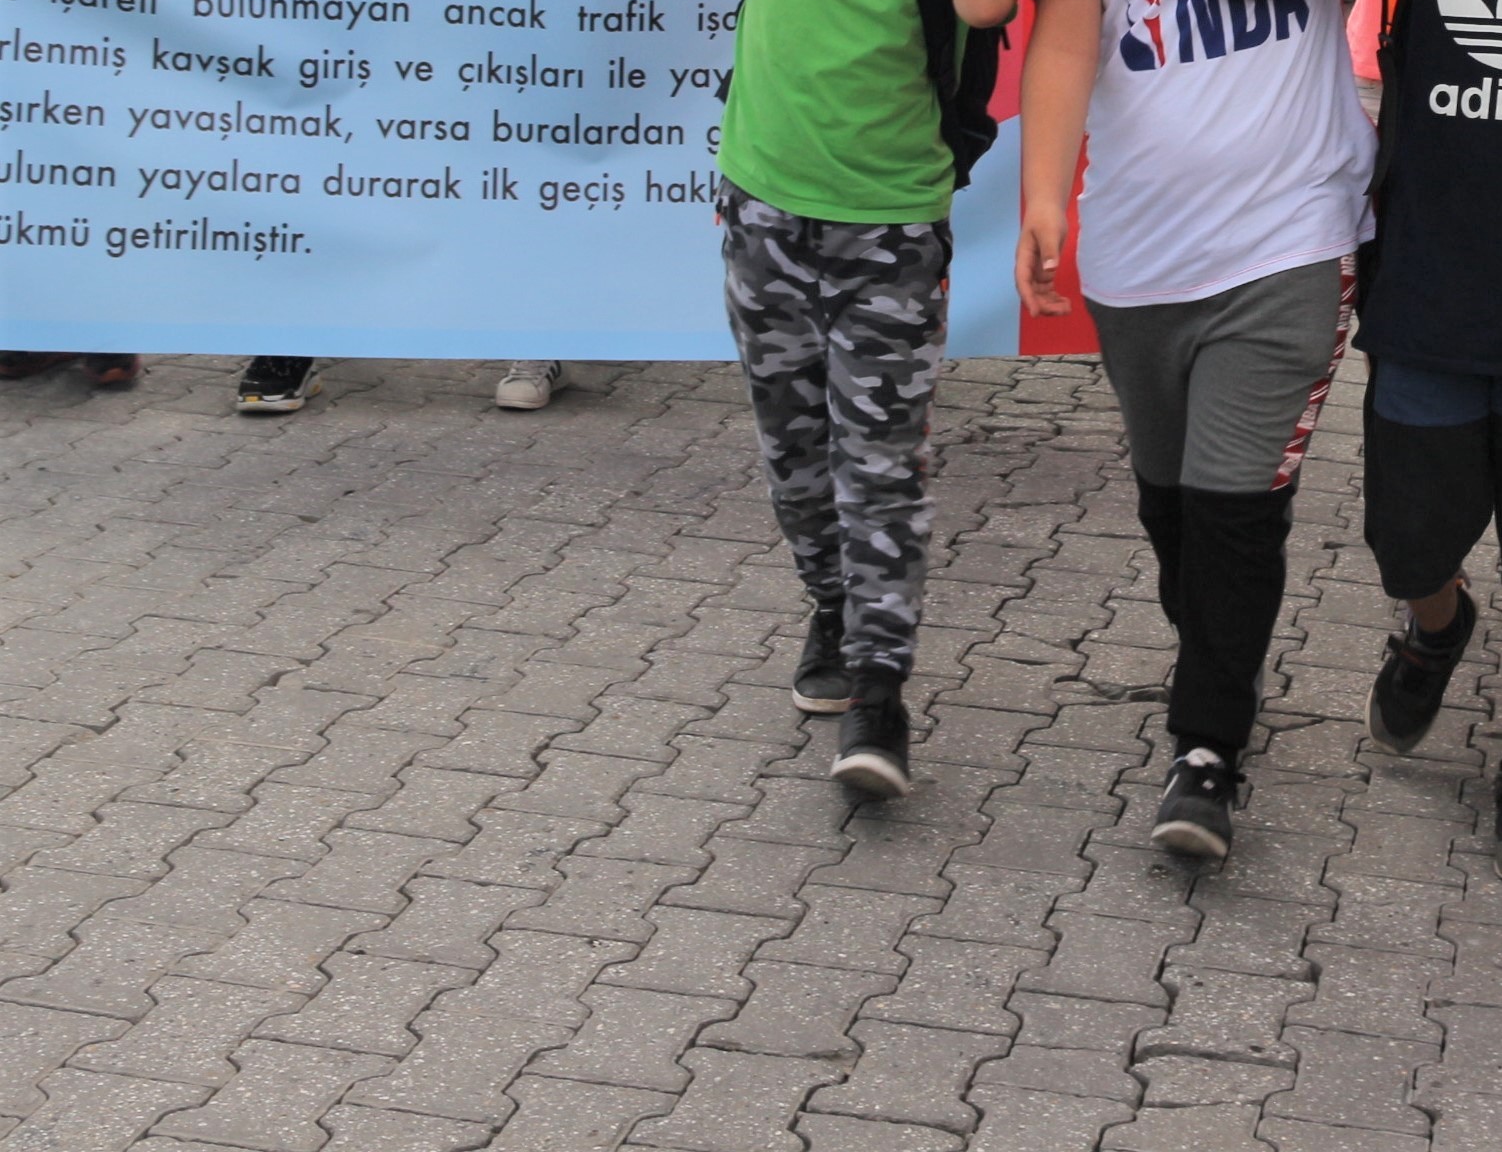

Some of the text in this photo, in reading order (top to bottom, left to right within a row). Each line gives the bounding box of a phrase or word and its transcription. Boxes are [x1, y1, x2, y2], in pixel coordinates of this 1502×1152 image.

[578, 0, 666, 32] trafik
[152, 37, 275, 83] kavşak
[299, 49, 372, 89] giriş
[395, 59, 434, 82] ve
[458, 50, 585, 94] çıkışları
[608, 56, 647, 89] ile
[128, 100, 354, 145] yavaşlamak,
[376, 116, 471, 142] varsa
[493, 109, 685, 146] buralardan
[138, 158, 301, 200] yayalara
[323, 163, 462, 200] durarak
[482, 167, 519, 200] ilk
[539, 172, 627, 212] geçiş
[106, 216, 313, 261] getirilmiştir.
